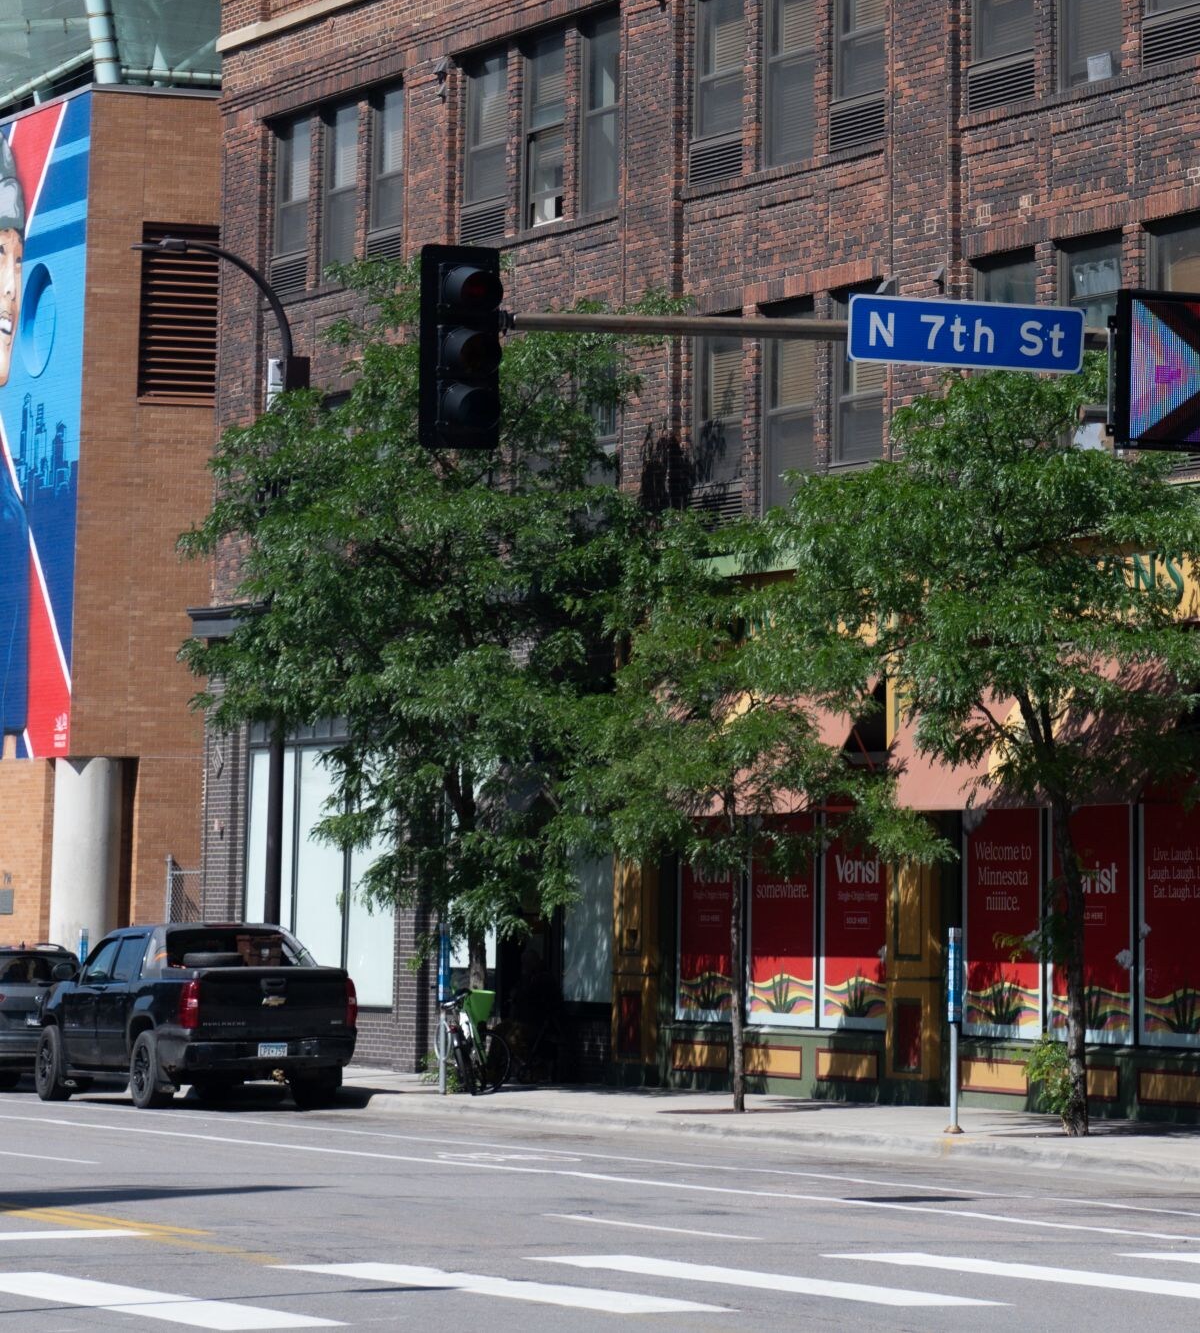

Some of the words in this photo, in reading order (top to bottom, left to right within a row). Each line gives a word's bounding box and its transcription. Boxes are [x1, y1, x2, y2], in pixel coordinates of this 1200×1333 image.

[868, 311, 895, 348] N
[920, 314, 995, 354] 7th
[1019, 320, 1065, 358] St
[974, 842, 1020, 861] Welcome
[1021, 844, 1032, 861] to
[1152, 846, 1170, 861] Live.
[1170, 846, 1195, 864] Laugh.
[835, 854, 881, 884] Verist
[977, 867, 1029, 886] Minnesota
[1080, 861, 1119, 894] rist
[1147, 866, 1170, 882] Laugh.
[1171, 866, 1196, 882] Laugh.
[756, 882, 809, 899] somewhere.
[1153, 885, 1168, 898] Eat.
[1168, 885, 1192, 901] Laugh.
